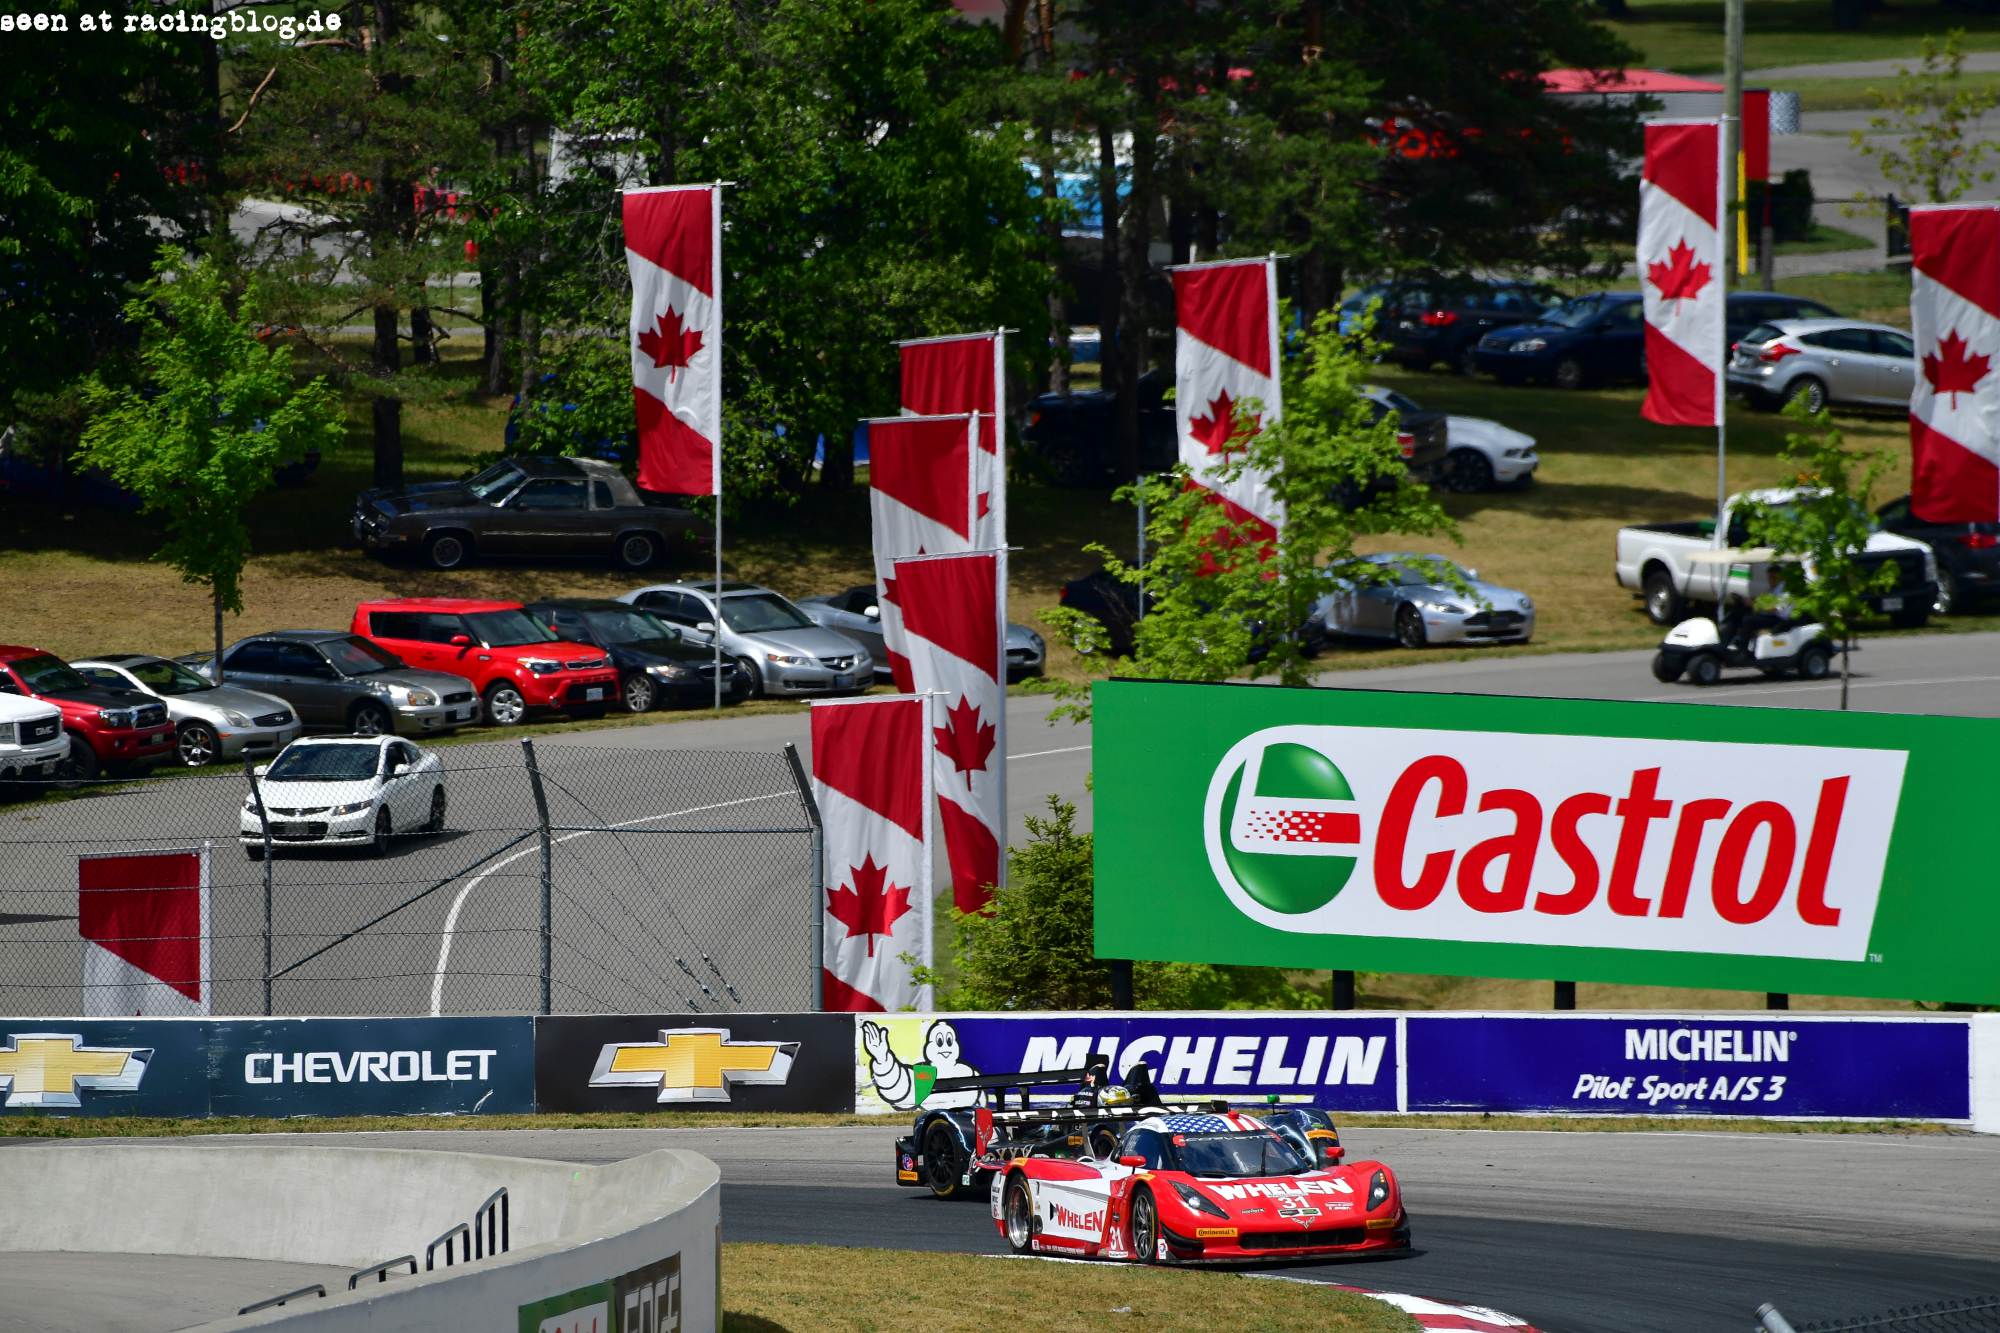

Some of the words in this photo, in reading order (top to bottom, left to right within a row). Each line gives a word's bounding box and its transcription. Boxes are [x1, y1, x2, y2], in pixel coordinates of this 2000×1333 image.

[1373, 754, 1851, 927] Castrol
[1625, 1028, 1789, 1062] MICHELIN
[244, 1050, 497, 1084] CHEVROLET
[1572, 1073, 1634, 1100] Pilot
[1637, 1075, 1708, 1106] Sport
[1709, 1075, 1764, 1102] A/S
[1763, 1075, 1787, 1102] 3
[1207, 1178, 1354, 1201] WHELEN
[1278, 1196, 1310, 1209] 31
[1055, 1203, 1105, 1233] WHELEN
[1199, 1229, 1231, 1237] Continental
[1109, 1226, 1124, 1251] 31
